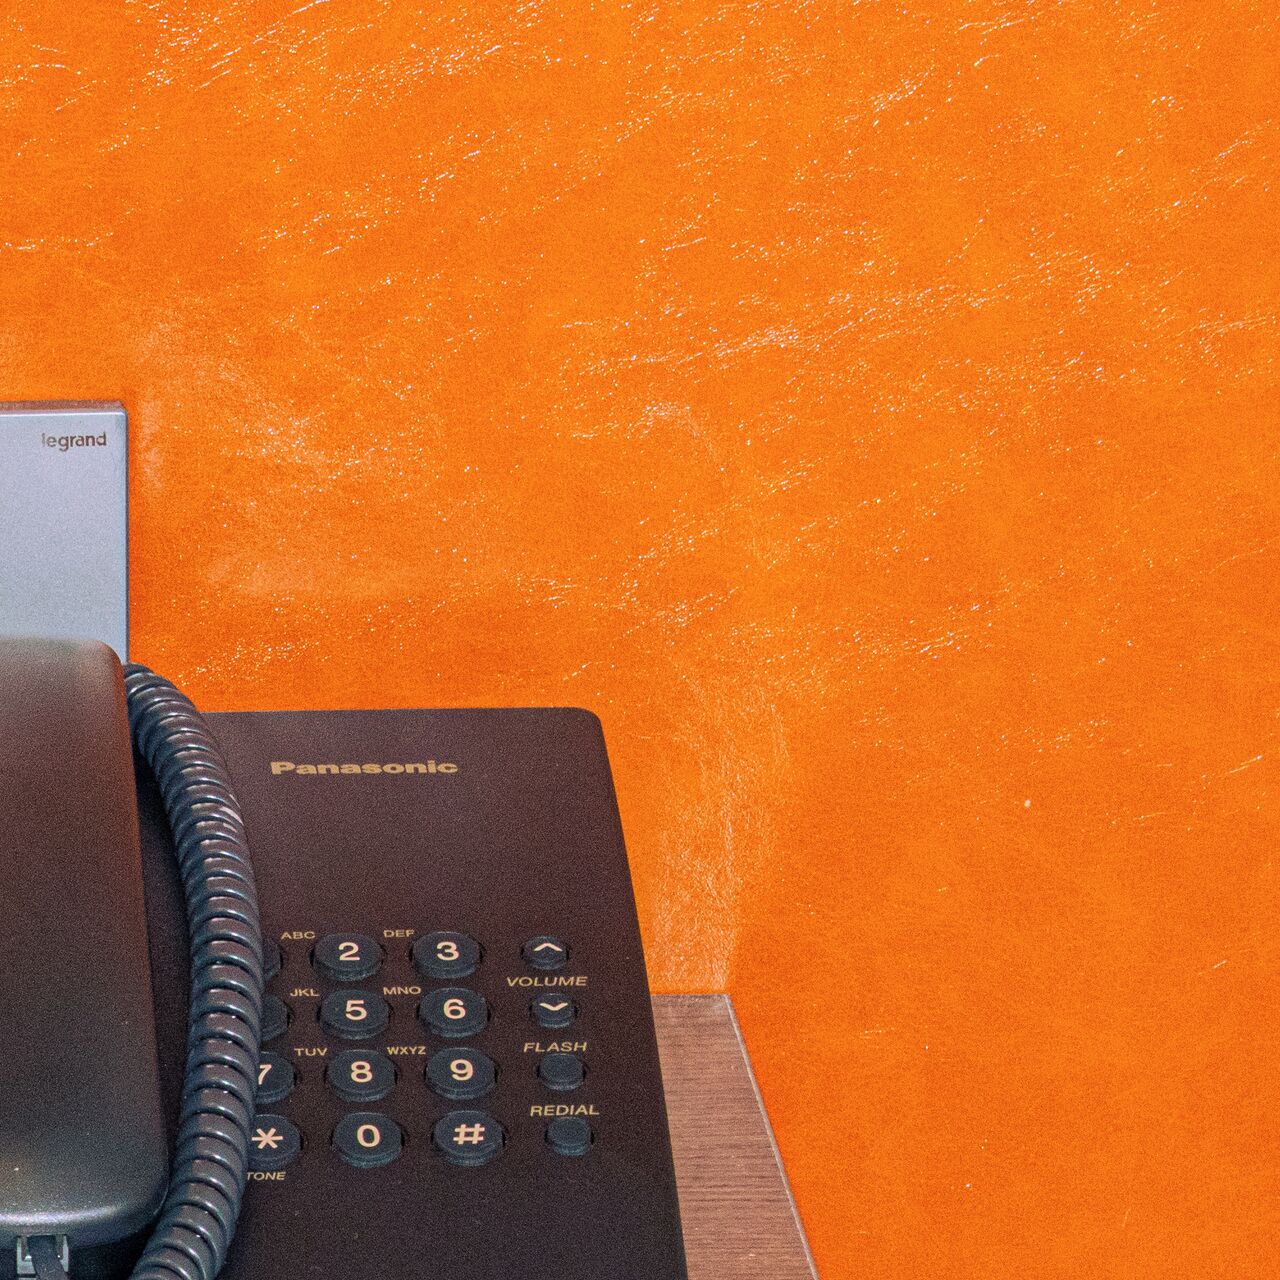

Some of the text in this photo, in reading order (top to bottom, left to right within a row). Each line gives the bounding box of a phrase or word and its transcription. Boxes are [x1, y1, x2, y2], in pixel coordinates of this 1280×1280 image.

[41, 432, 107, 452] legrand
[271, 760, 459, 775] Panasonic
[281, 931, 316, 939] ABC
[383, 930, 415, 938] DEF
[338, 942, 361, 961] 2
[436, 942, 459, 961] 3
[506, 976, 588, 988] VOLUME
[290, 988, 320, 997] JKL
[383, 986, 422, 995] MNO
[345, 1000, 368, 1020] 5
[443, 1000, 467, 1020] 6
[294, 1048, 328, 1056] TUV
[386, 1046, 427, 1055] WXYZ
[523, 1041, 588, 1053] FLASH
[258, 1063, 272, 1085] 7
[350, 1061, 373, 1082] 8
[450, 1059, 474, 1081] 9
[530, 1104, 600, 1116] REDIAL
[356, 1125, 380, 1147] 0
[247, 1171, 287, 1181] TONE
